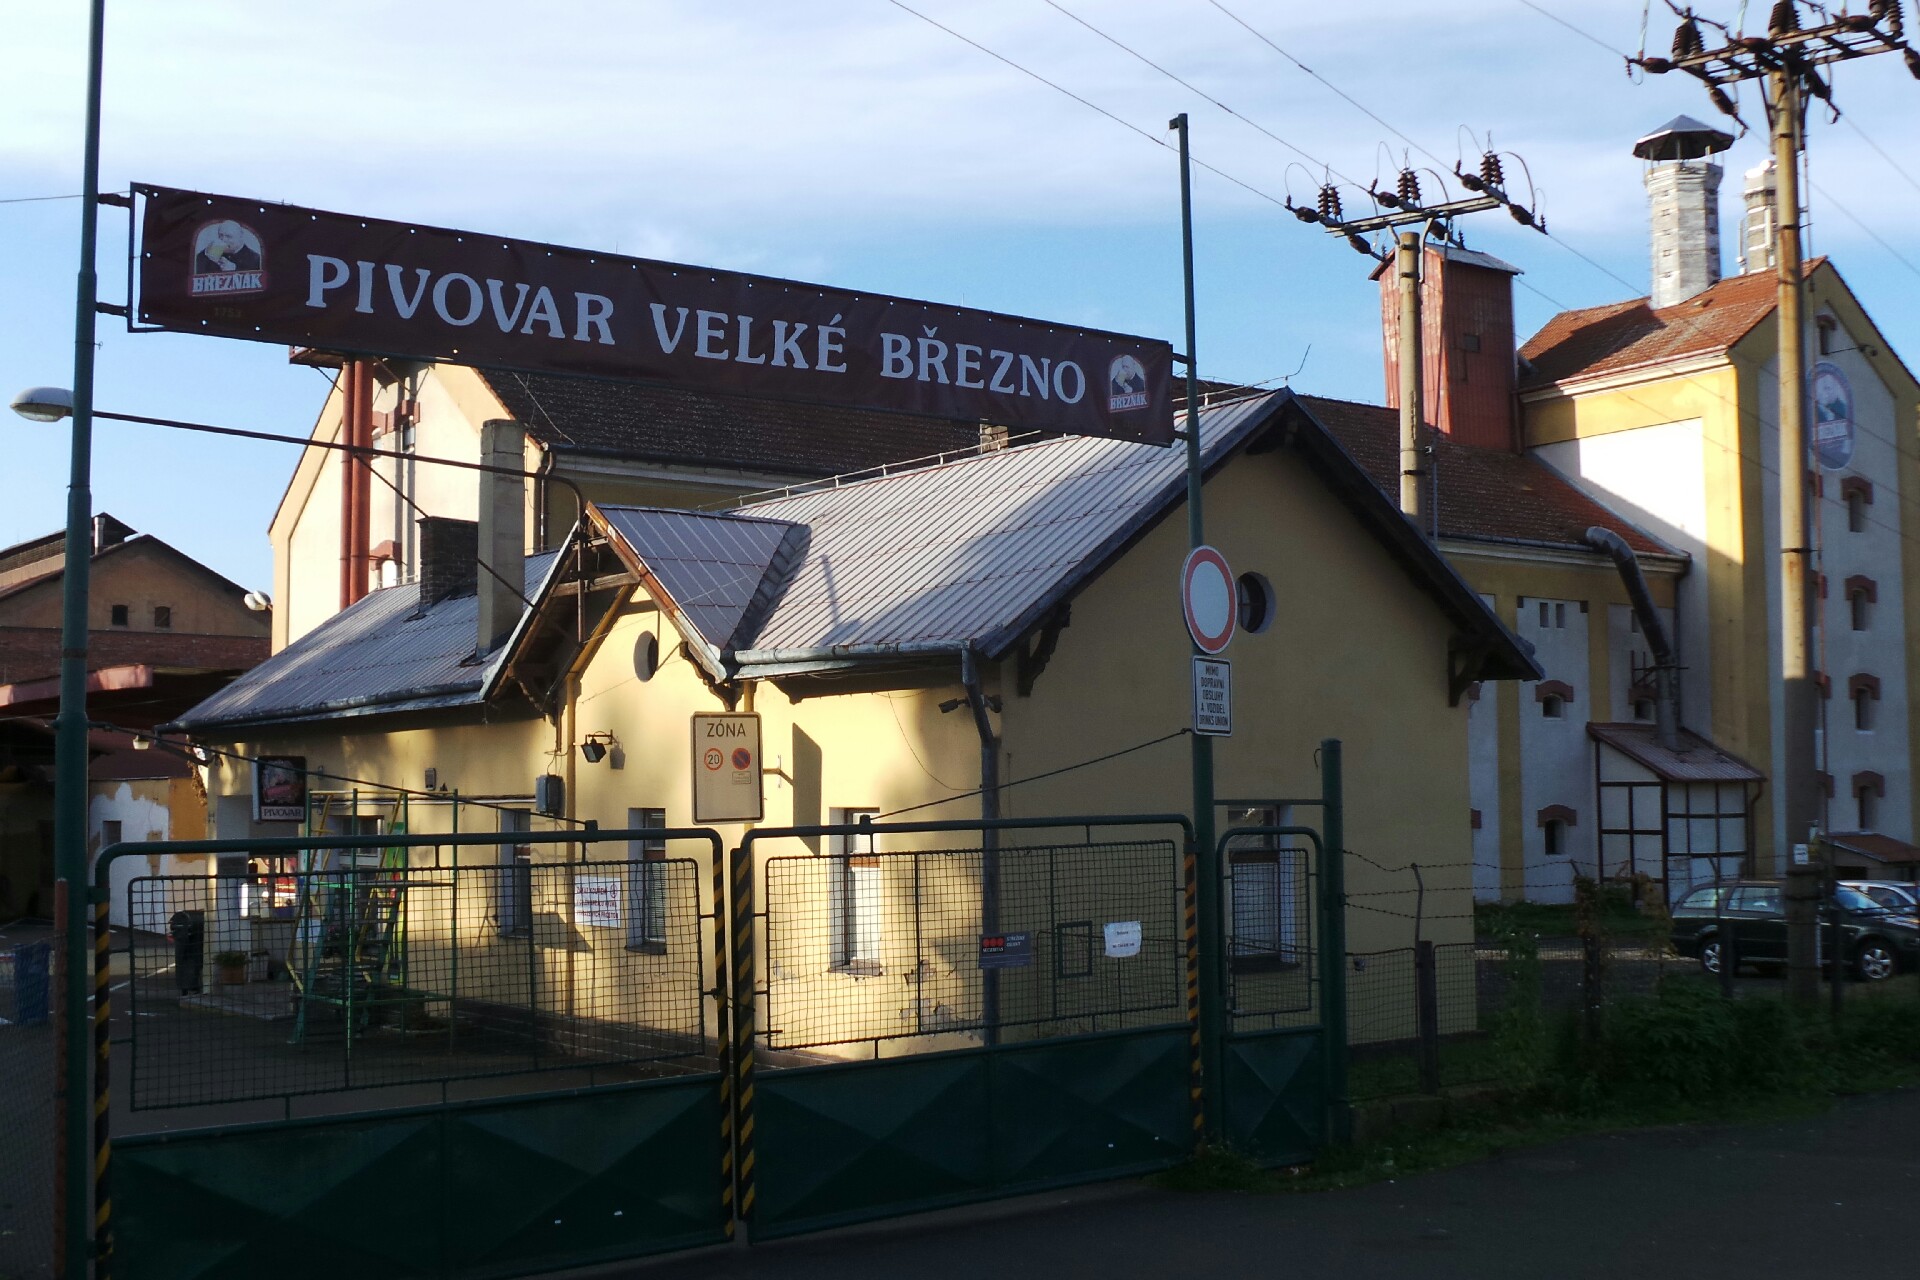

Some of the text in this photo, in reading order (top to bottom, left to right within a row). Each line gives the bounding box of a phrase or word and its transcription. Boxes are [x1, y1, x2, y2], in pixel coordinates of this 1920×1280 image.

[306, 254, 1086, 404] PIVOVAR VELKÉ BŘEZNO
[1205, 664, 1219, 676] MIMO
[1206, 703, 1226, 714] VOZIDEL
[707, 719, 746, 738] ZÓNA
[707, 754, 720, 765] 20
[263, 808, 303, 817] PIVOVAR
